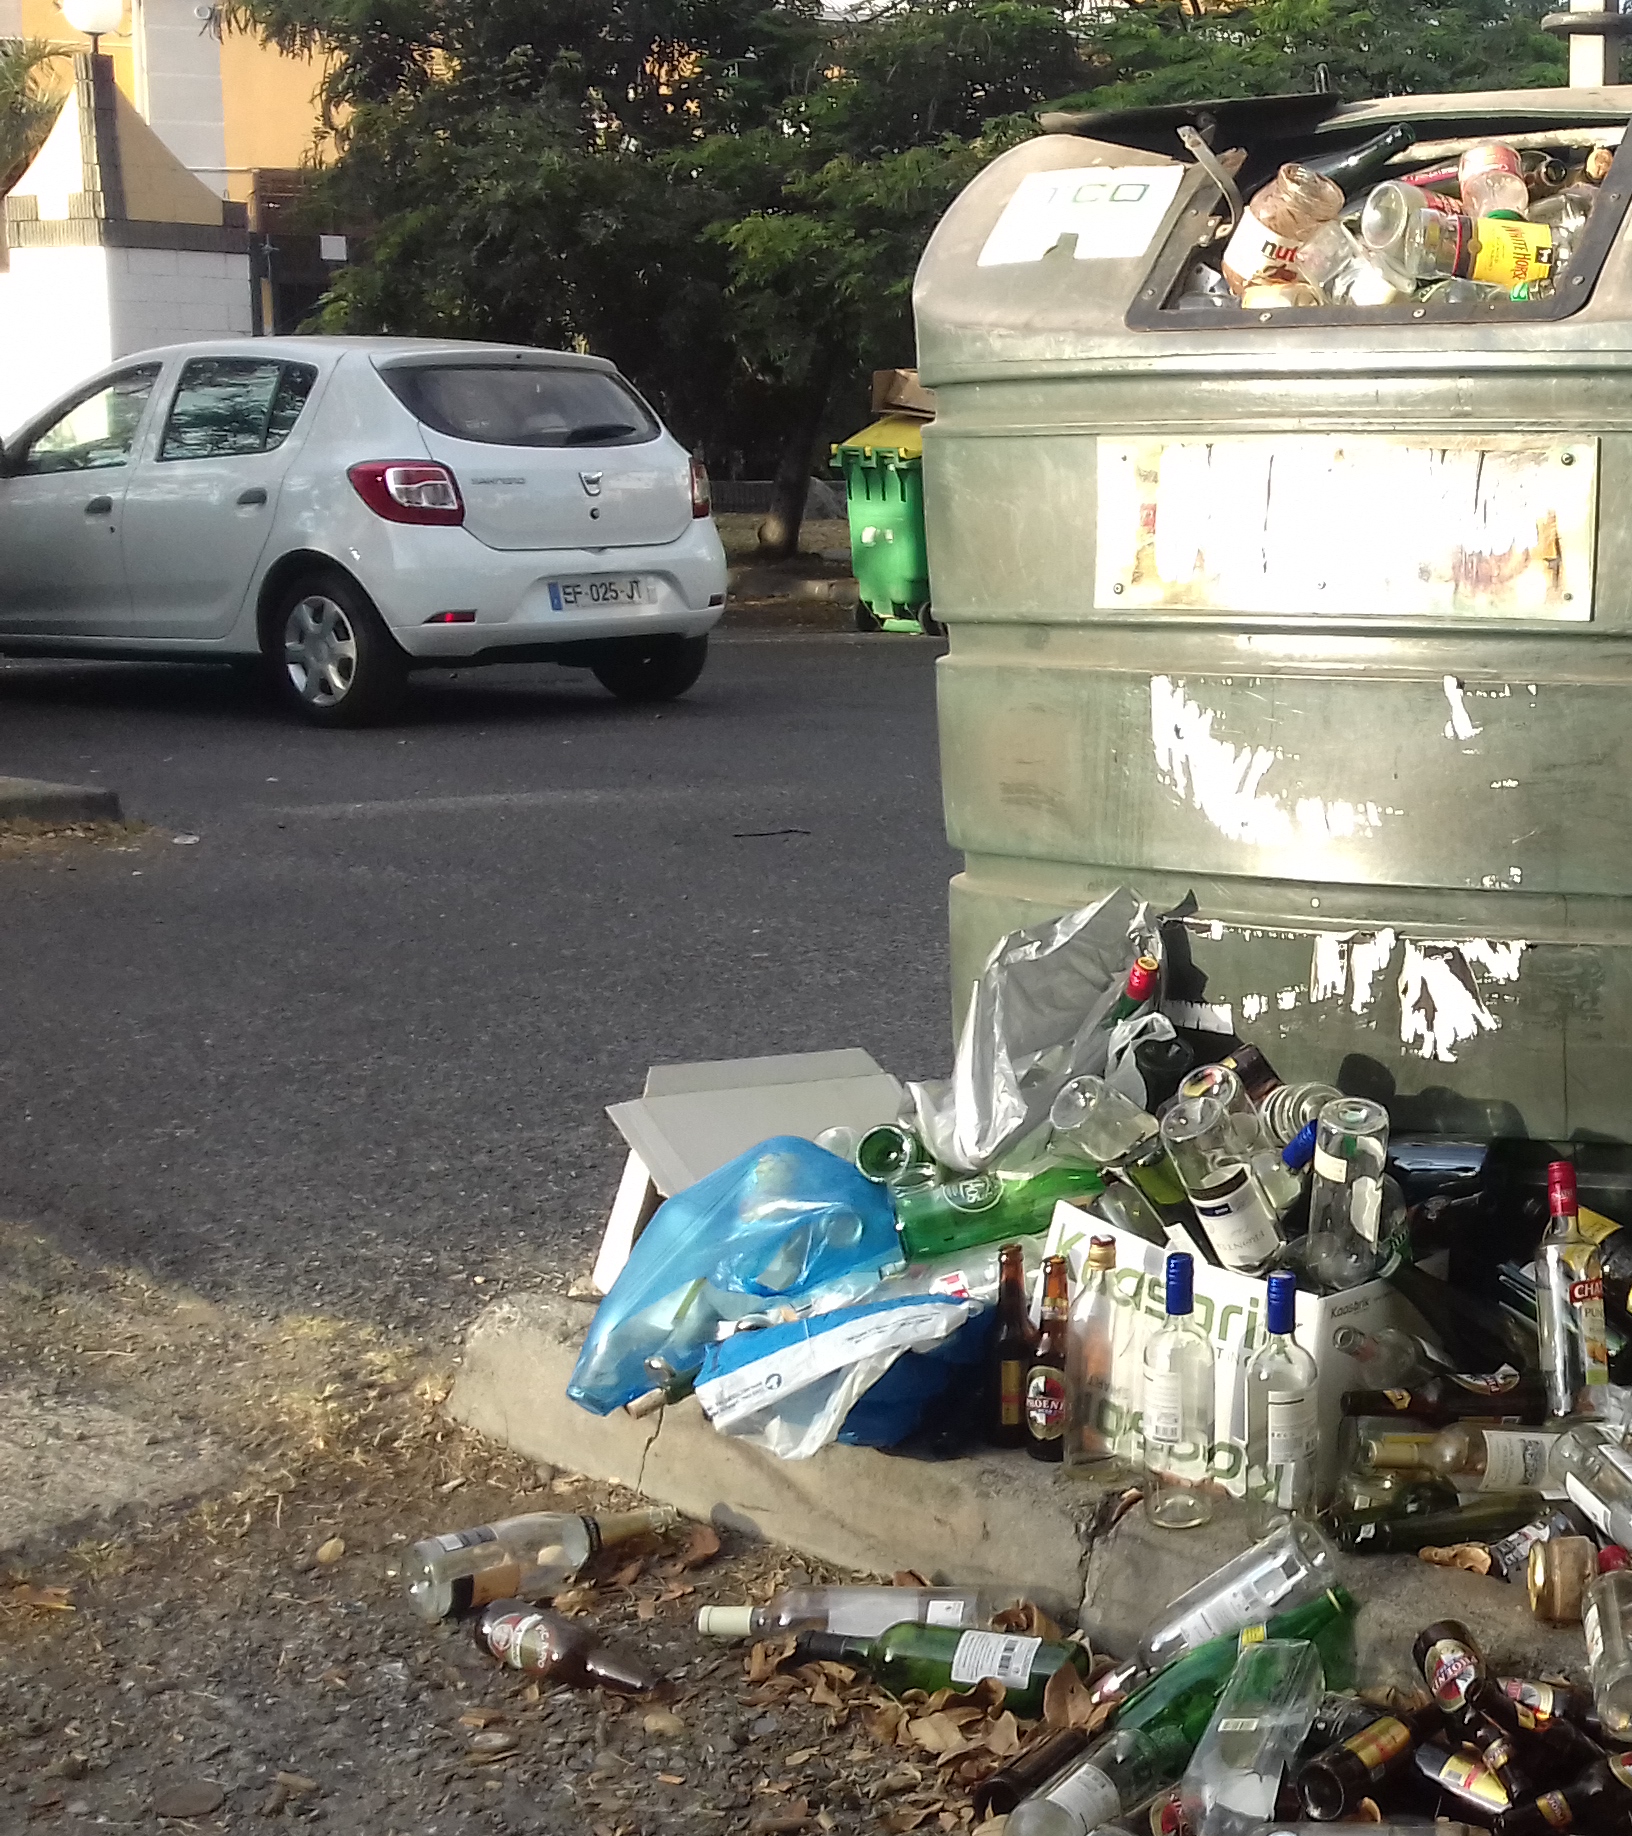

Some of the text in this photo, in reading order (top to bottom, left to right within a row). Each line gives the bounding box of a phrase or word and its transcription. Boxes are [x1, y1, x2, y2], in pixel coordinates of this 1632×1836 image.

[1501, 226, 1529, 252] WHITE
[1261, 238, 1300, 264] nut
[1573, 1281, 1603, 1298] CHA
[1584, 1306, 1604, 1318] PUN
